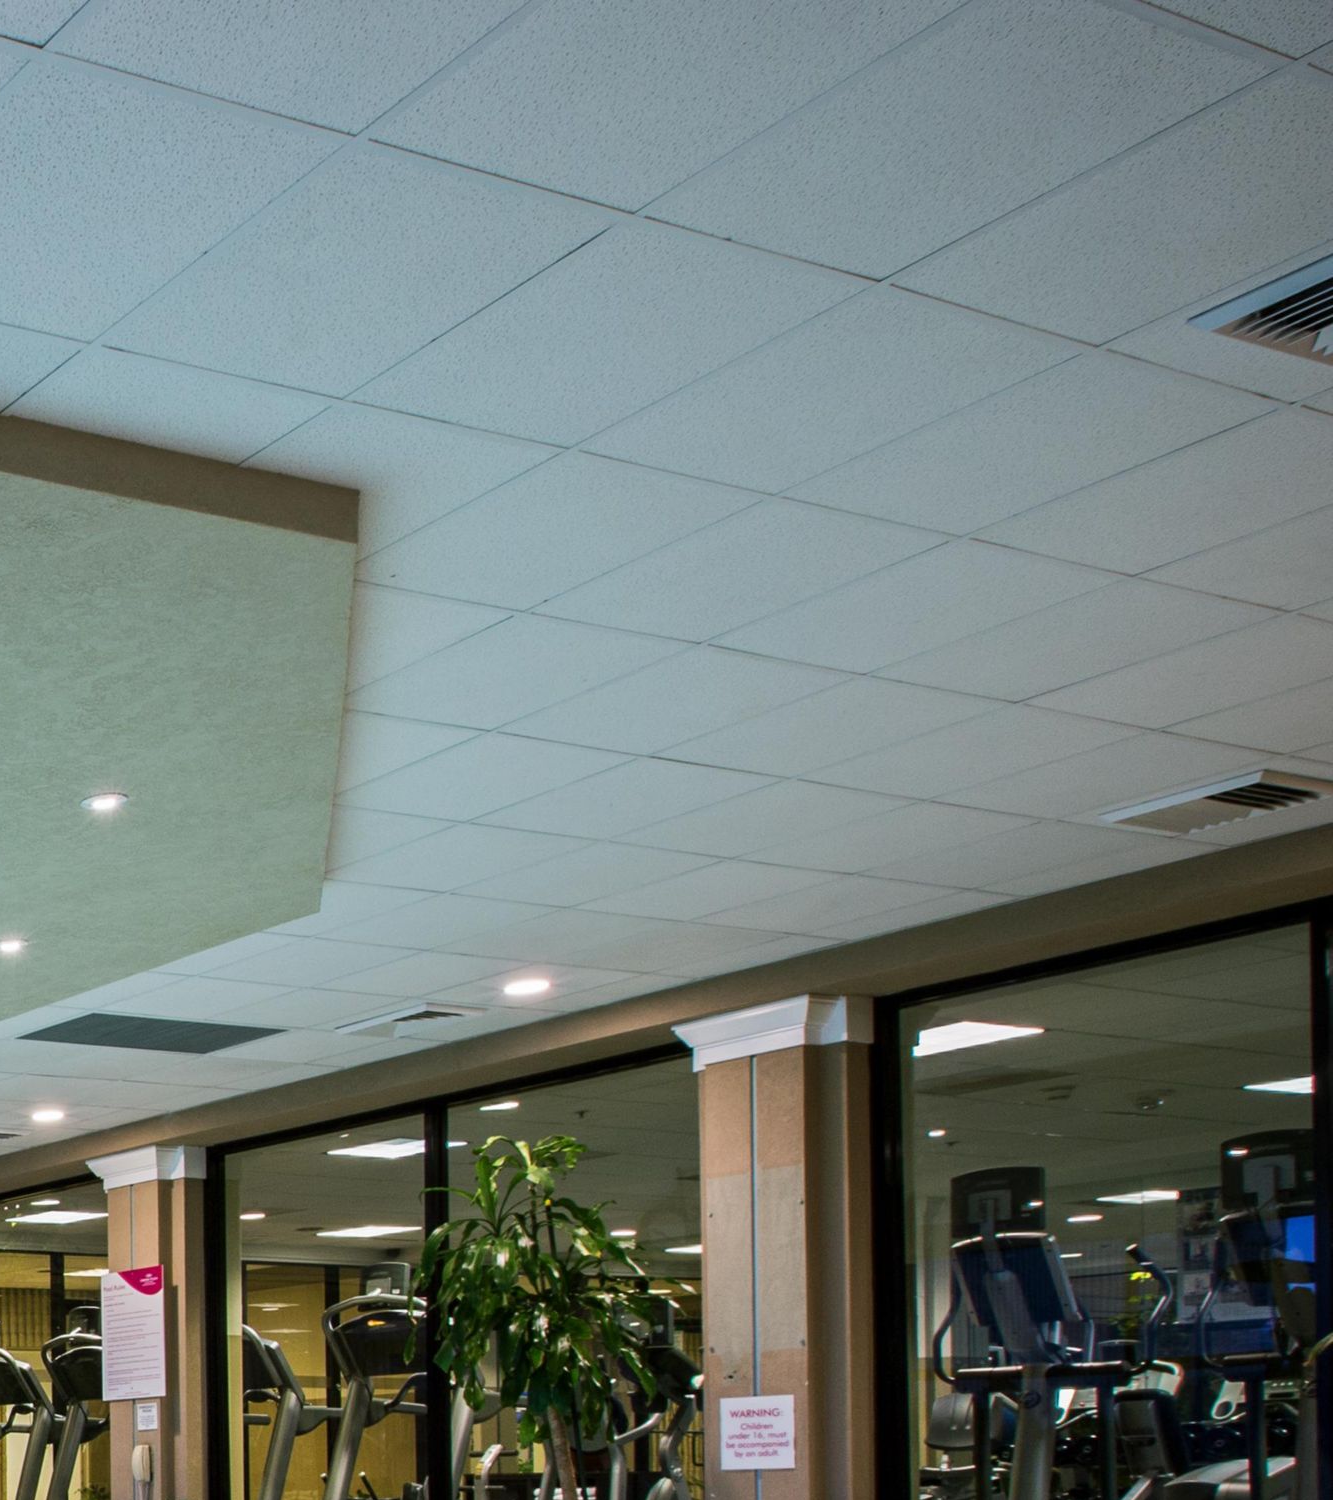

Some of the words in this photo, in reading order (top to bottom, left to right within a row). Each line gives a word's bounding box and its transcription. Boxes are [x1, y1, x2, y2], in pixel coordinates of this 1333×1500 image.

[740, 1422, 773, 1430] Children
[728, 1432, 750, 1440] under
[738, 1440, 789, 1450] accompanied
[734, 1450, 743, 1459] by
